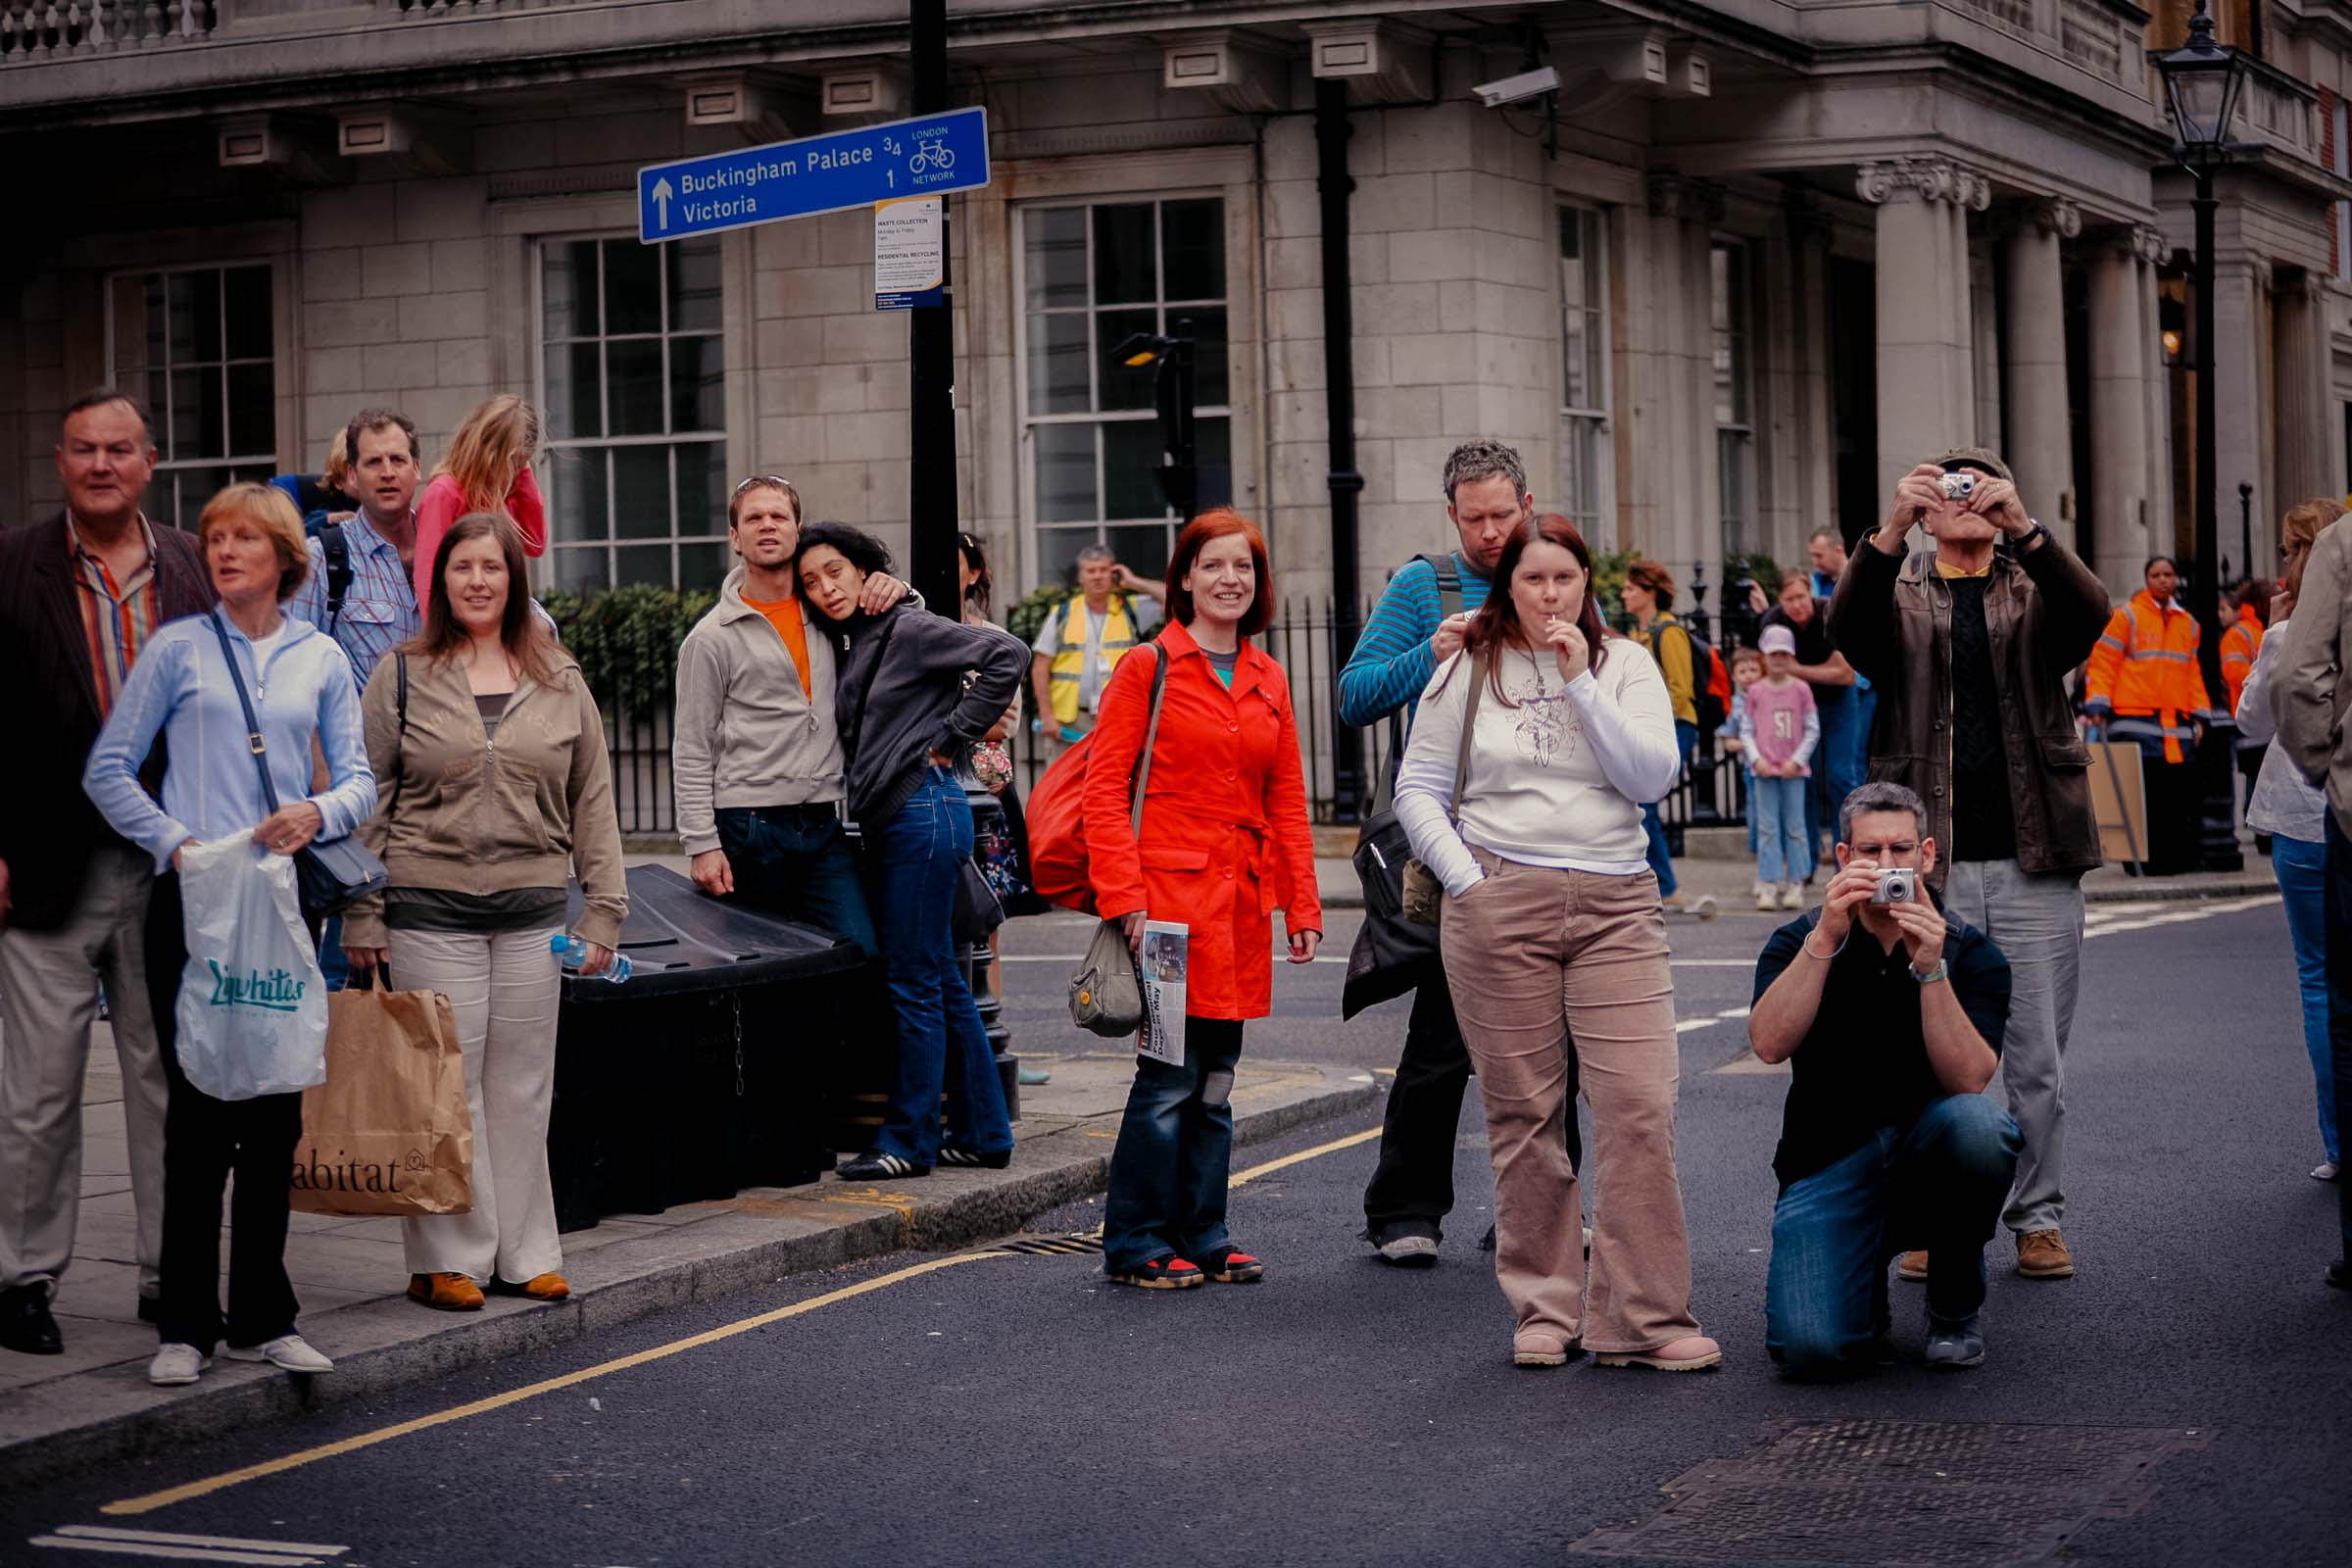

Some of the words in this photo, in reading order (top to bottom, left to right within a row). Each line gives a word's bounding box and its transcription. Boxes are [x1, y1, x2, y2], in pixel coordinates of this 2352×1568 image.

[911, 126, 949, 141] LONDON
[681, 160, 798, 195] Buckingham
[807, 146, 873, 172] Palace
[912, 171, 956, 185] NETWORK
[683, 195, 758, 223] Victoria
[886, 169, 894, 189] 1
[291, 1148, 401, 1193] abitat
